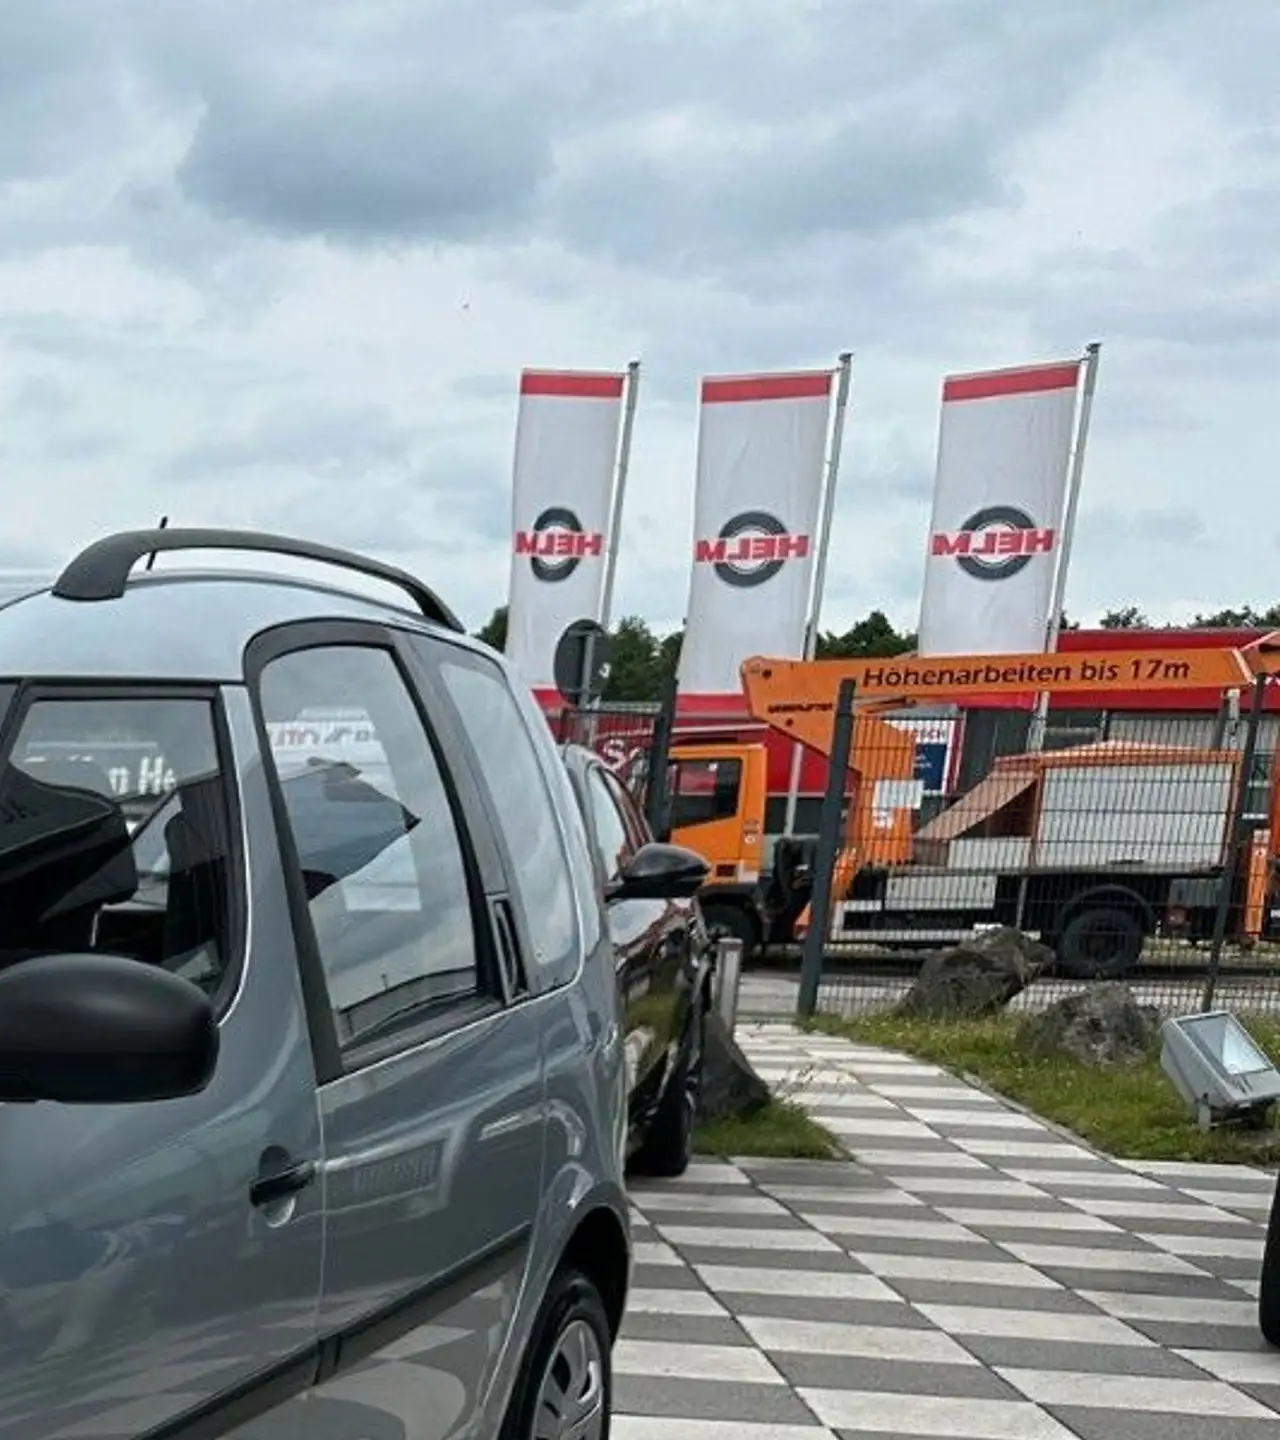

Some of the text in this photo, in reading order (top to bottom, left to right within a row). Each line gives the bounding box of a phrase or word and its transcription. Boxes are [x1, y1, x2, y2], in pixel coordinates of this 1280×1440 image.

[862, 658, 1190, 688] Höhenarbeiten bis 17m
